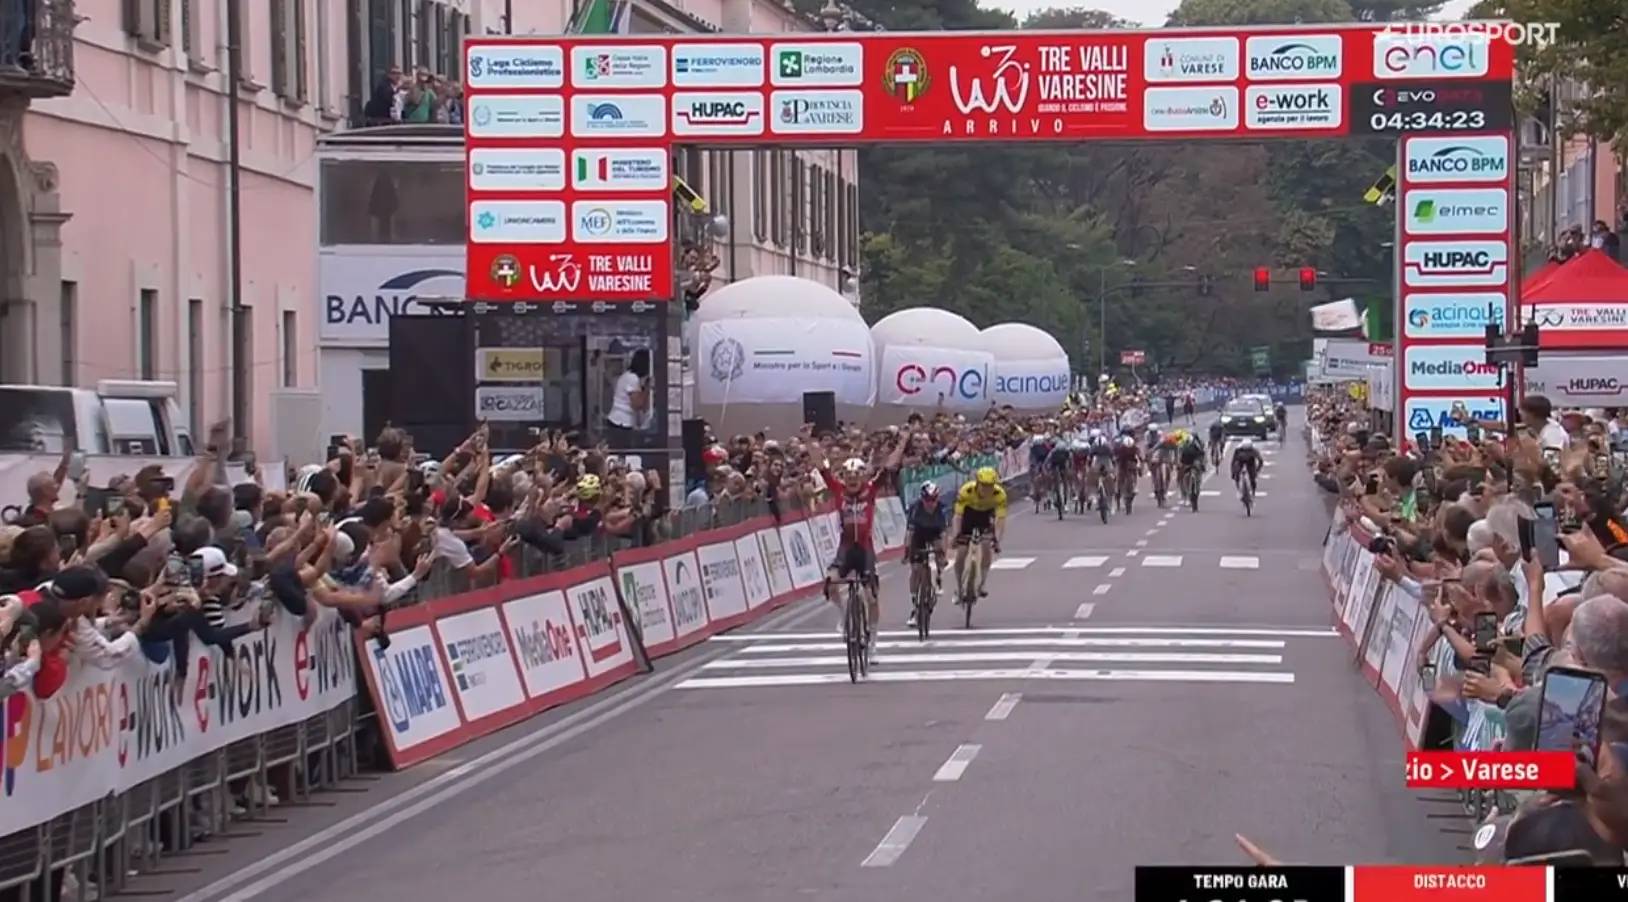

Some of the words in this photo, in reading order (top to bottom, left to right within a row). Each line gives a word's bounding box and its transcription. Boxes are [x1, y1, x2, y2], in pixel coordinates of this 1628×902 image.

[691, 57, 762, 66] FERROVIENORD
[804, 54, 842, 65] Regione
[1038, 46, 1071, 71] TRE
[1079, 45, 1127, 71] VALLI
[1251, 56, 1304, 71] BANCO
[1307, 56, 1336, 70] BPM
[1385, 42, 1477, 71] enel
[804, 63, 854, 73] Lombardia
[1181, 64, 1224, 74] VARESE
[1038, 75, 1127, 99] VARESINE
[1256, 88, 1329, 109] e-work
[692, 102, 744, 117] HUPAC
[943, 119, 1063, 134] ARRIVO
[1370, 111, 1485, 130] 04:34:23
[1409, 158, 1467, 172] BANCO
[1471, 158, 1504, 171] BPM
[1439, 205, 1498, 217] elmec
[581, 216, 607, 229] MEF
[588, 255, 612, 272] TRE
[617, 255, 652, 271] VALLI
[1424, 251, 1489, 268] HUPAC
[588, 275, 652, 292] VARESINE
[327, 295, 419, 324] BANC
[1432, 303, 1503, 320] acinque
[1412, 360, 1498, 375] MediaOne
[897, 363, 988, 399] enel
[996, 374, 1068, 393] acinque
[1524, 382, 1545, 392] PM
[1569, 378, 1618, 389] HUPAC
[1439, 410, 1500, 428] MPEI
[578, 587, 614, 638] HUPAC
[515, 618, 573, 670] MediaOne
[194, 628, 281, 733] e-work
[395, 644, 447, 718] MAPEI
[118, 670, 185, 768] e-work
